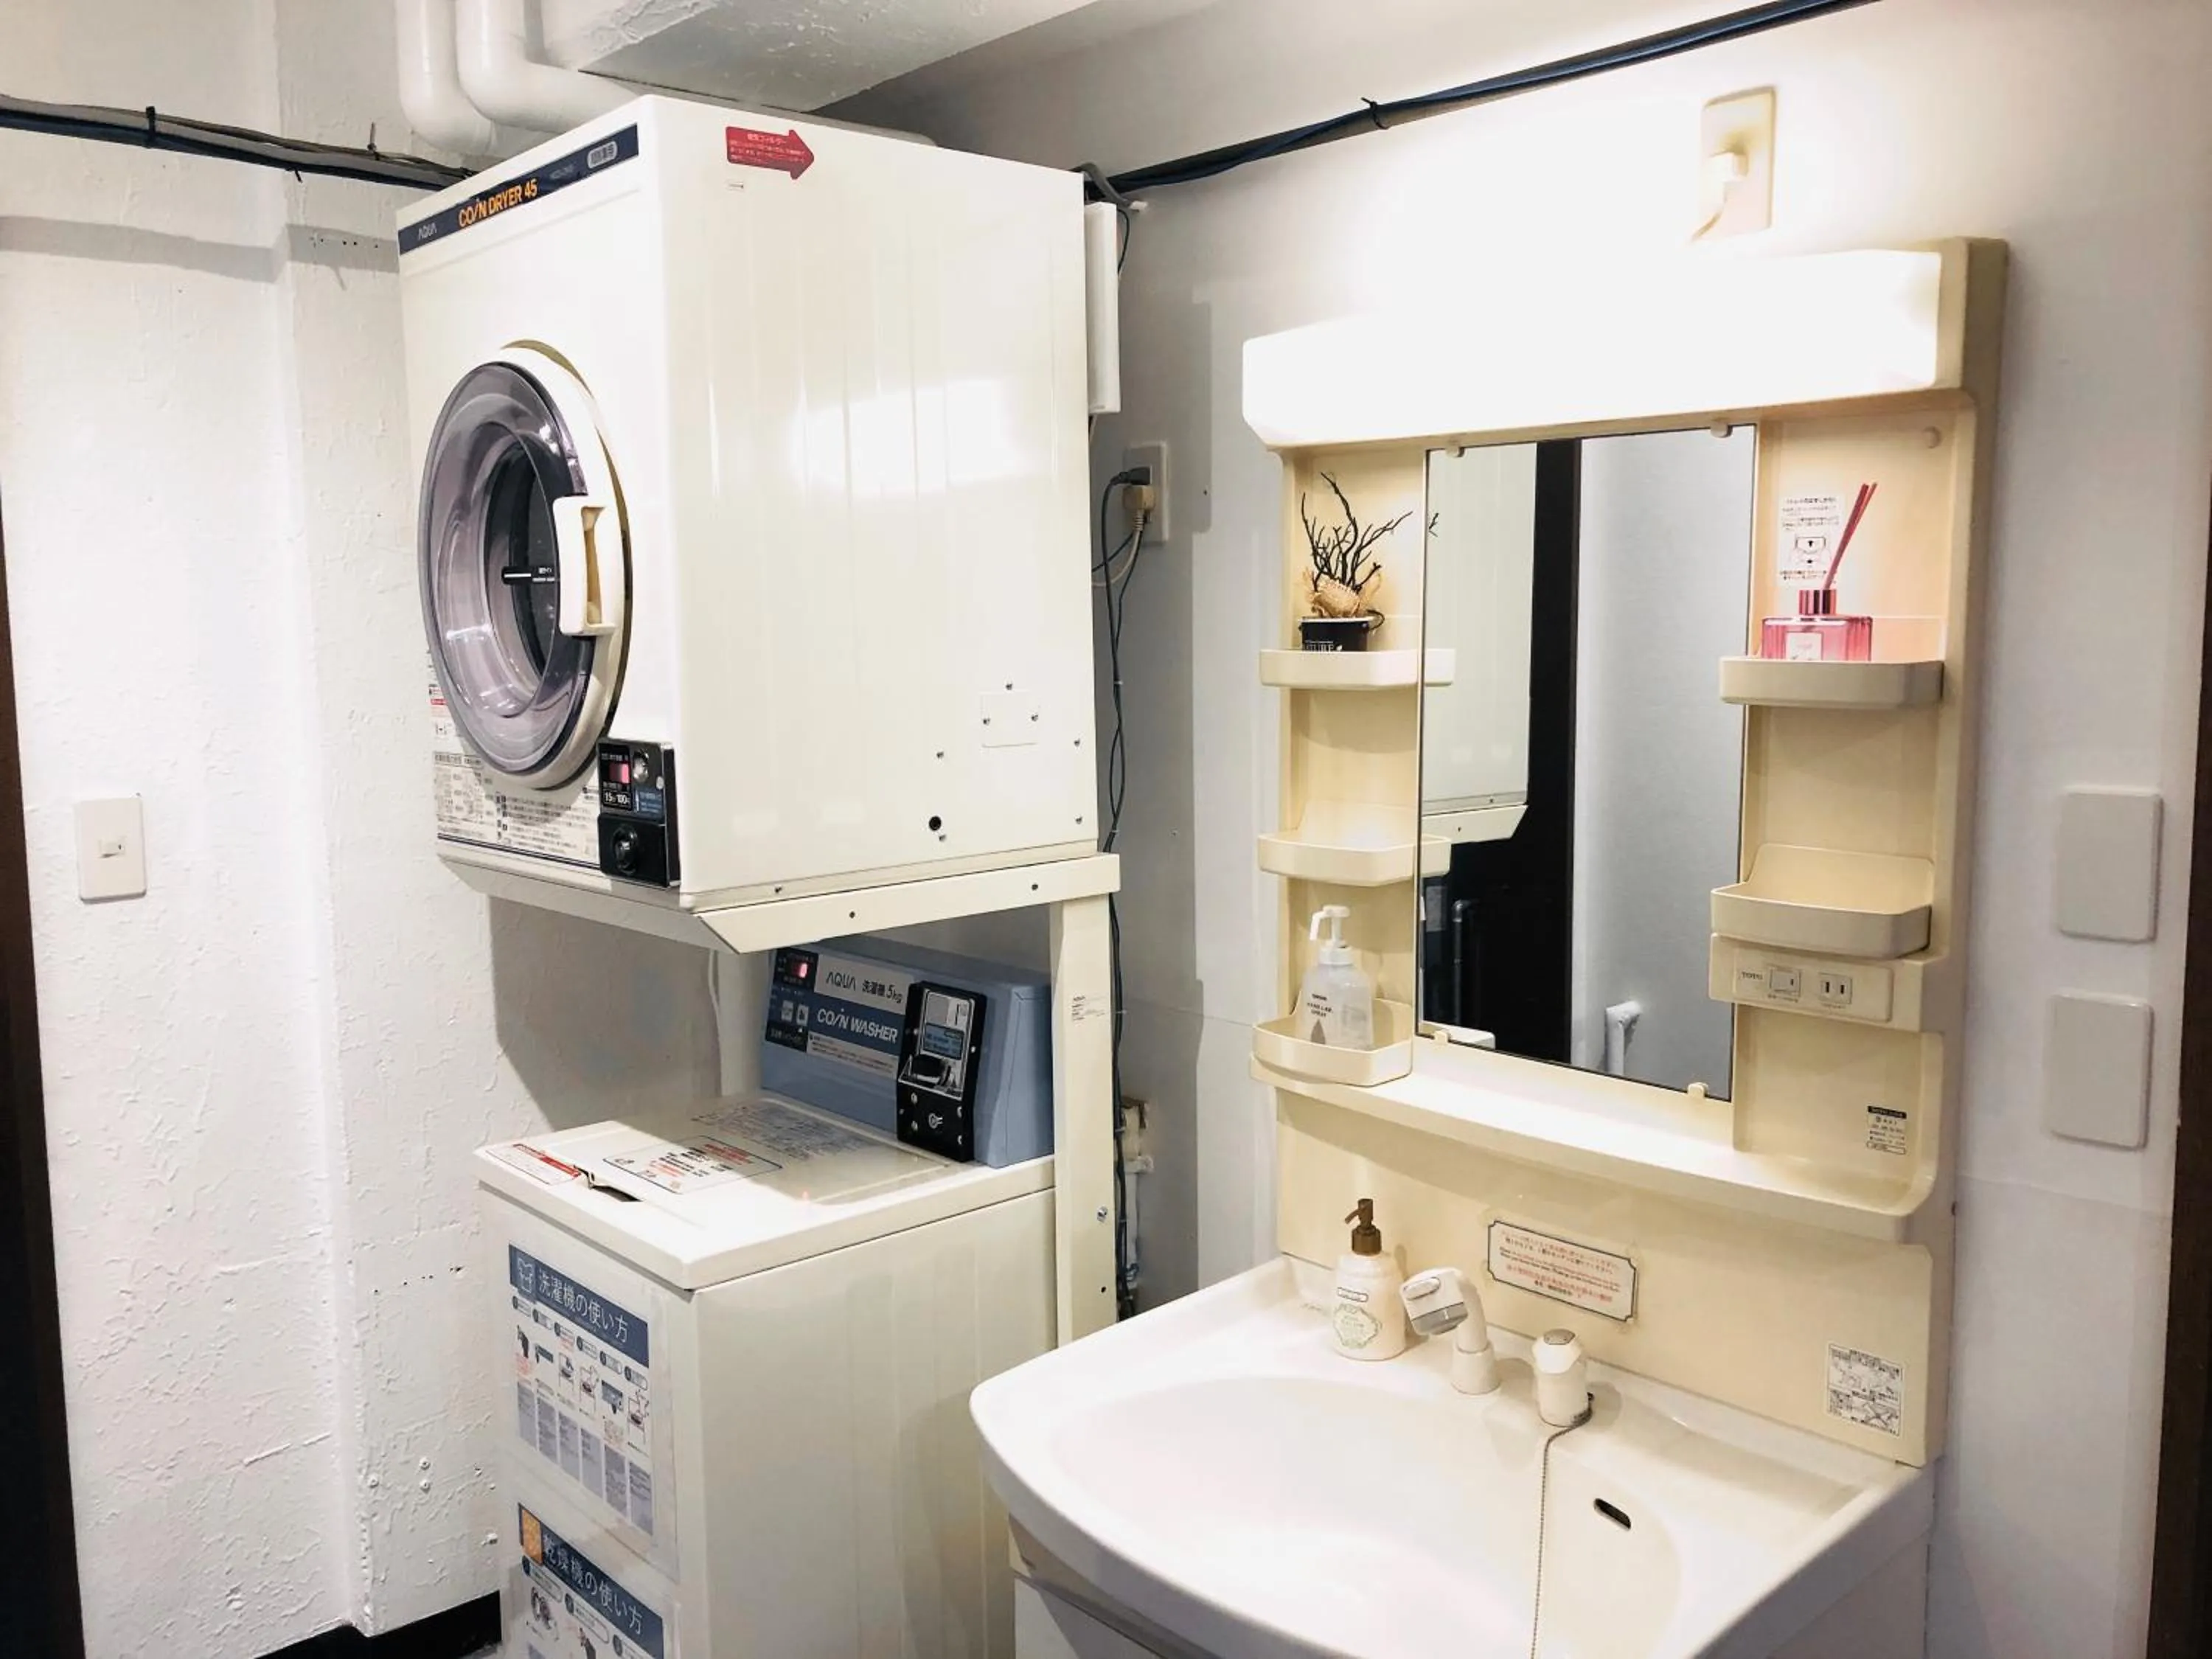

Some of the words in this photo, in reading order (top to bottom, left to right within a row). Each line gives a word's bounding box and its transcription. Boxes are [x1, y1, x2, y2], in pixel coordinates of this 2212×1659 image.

[417, 222, 437, 241] AQUA
[488, 186, 522, 215] DRYER
[524, 178, 538, 199] 45
[826, 971, 856, 991] AQUA
[817, 1007, 849, 1030] COIN
[850, 1018, 898, 1044] WASHER
[538, 1268, 628, 1343] 洗濯機の使い方
